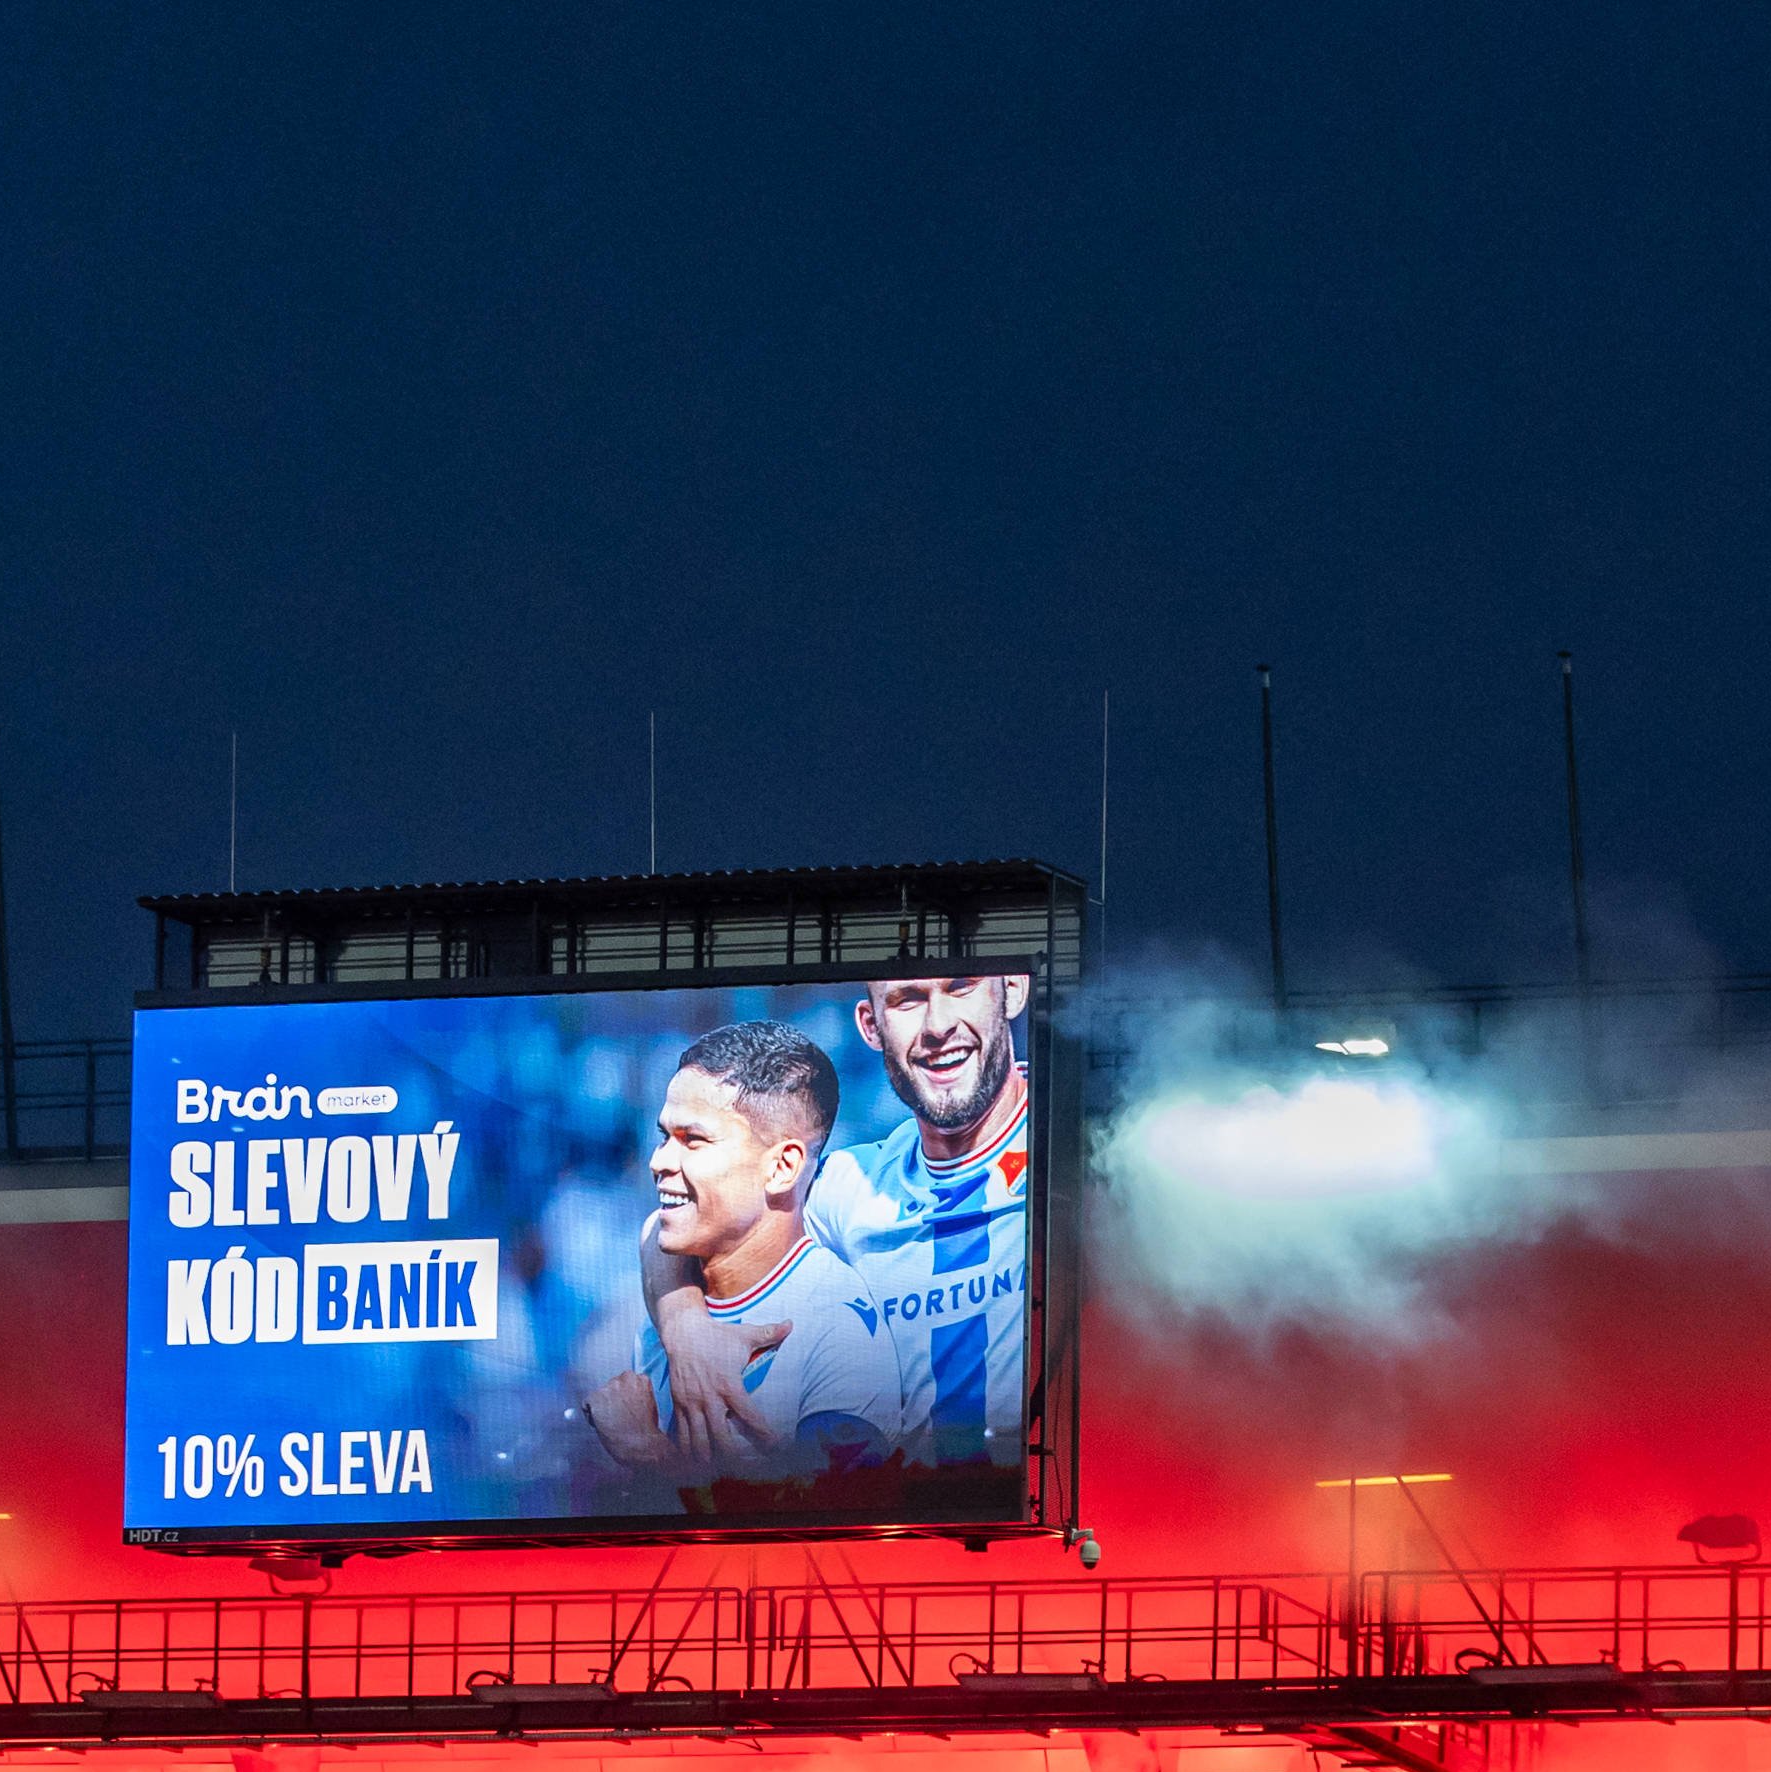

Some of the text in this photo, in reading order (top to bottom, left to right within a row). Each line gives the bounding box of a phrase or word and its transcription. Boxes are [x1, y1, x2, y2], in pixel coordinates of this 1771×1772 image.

[177, 1073, 388, 1123] Brain market
[168, 1120, 461, 1228] SLEVOVÝ
[166, 1246, 478, 1346] KÓD BANÍK
[158, 1429, 433, 1499] 10% SLEVA
